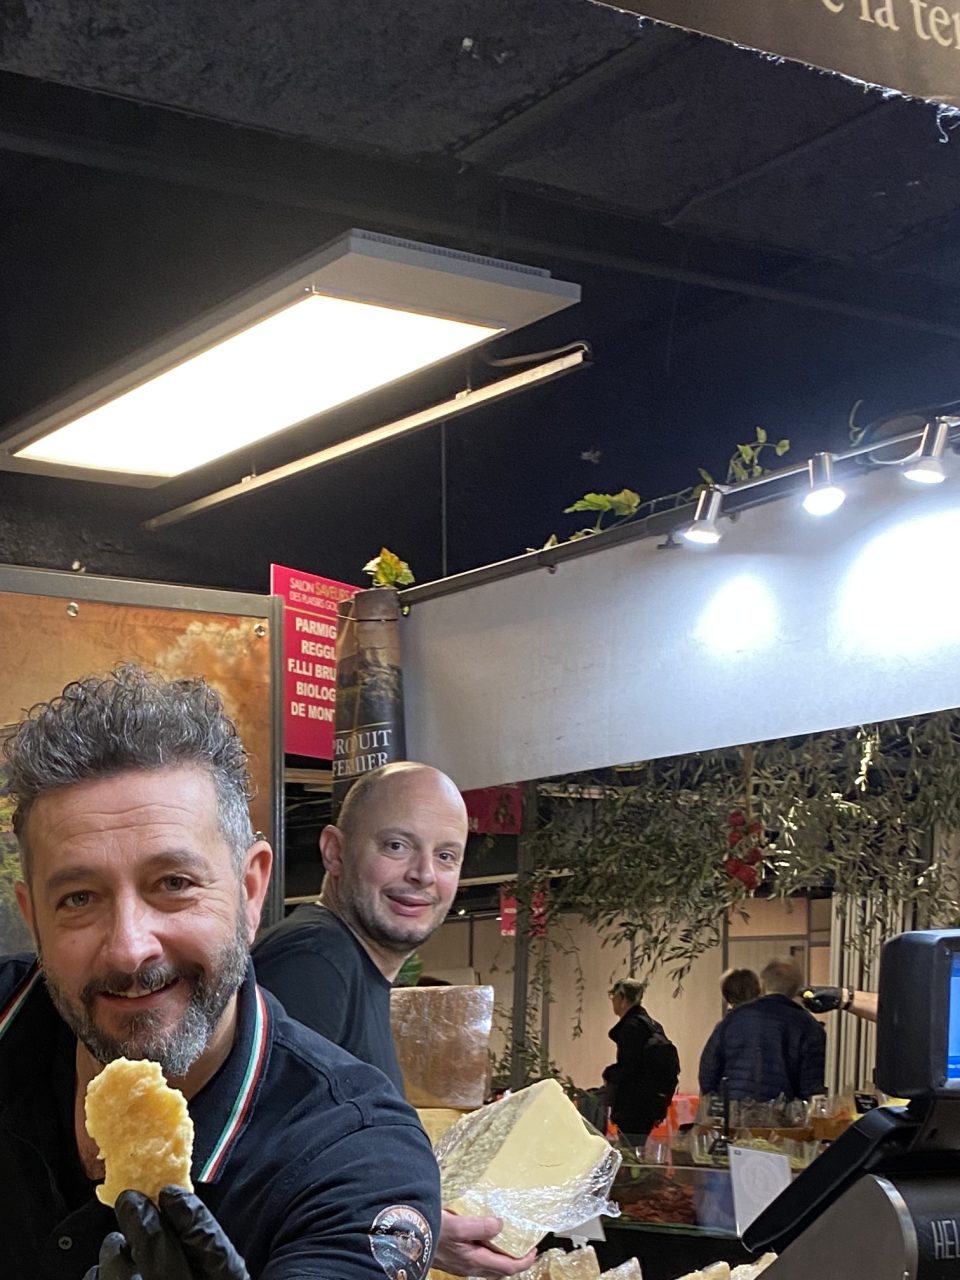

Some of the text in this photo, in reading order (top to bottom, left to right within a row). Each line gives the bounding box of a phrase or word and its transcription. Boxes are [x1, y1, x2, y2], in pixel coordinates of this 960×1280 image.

[296, 617, 337, 639] PARMIG
[288, 658, 313, 676] F.LLI
[296, 681, 336, 701] BIOLOG
[291, 701, 306, 717] DE
